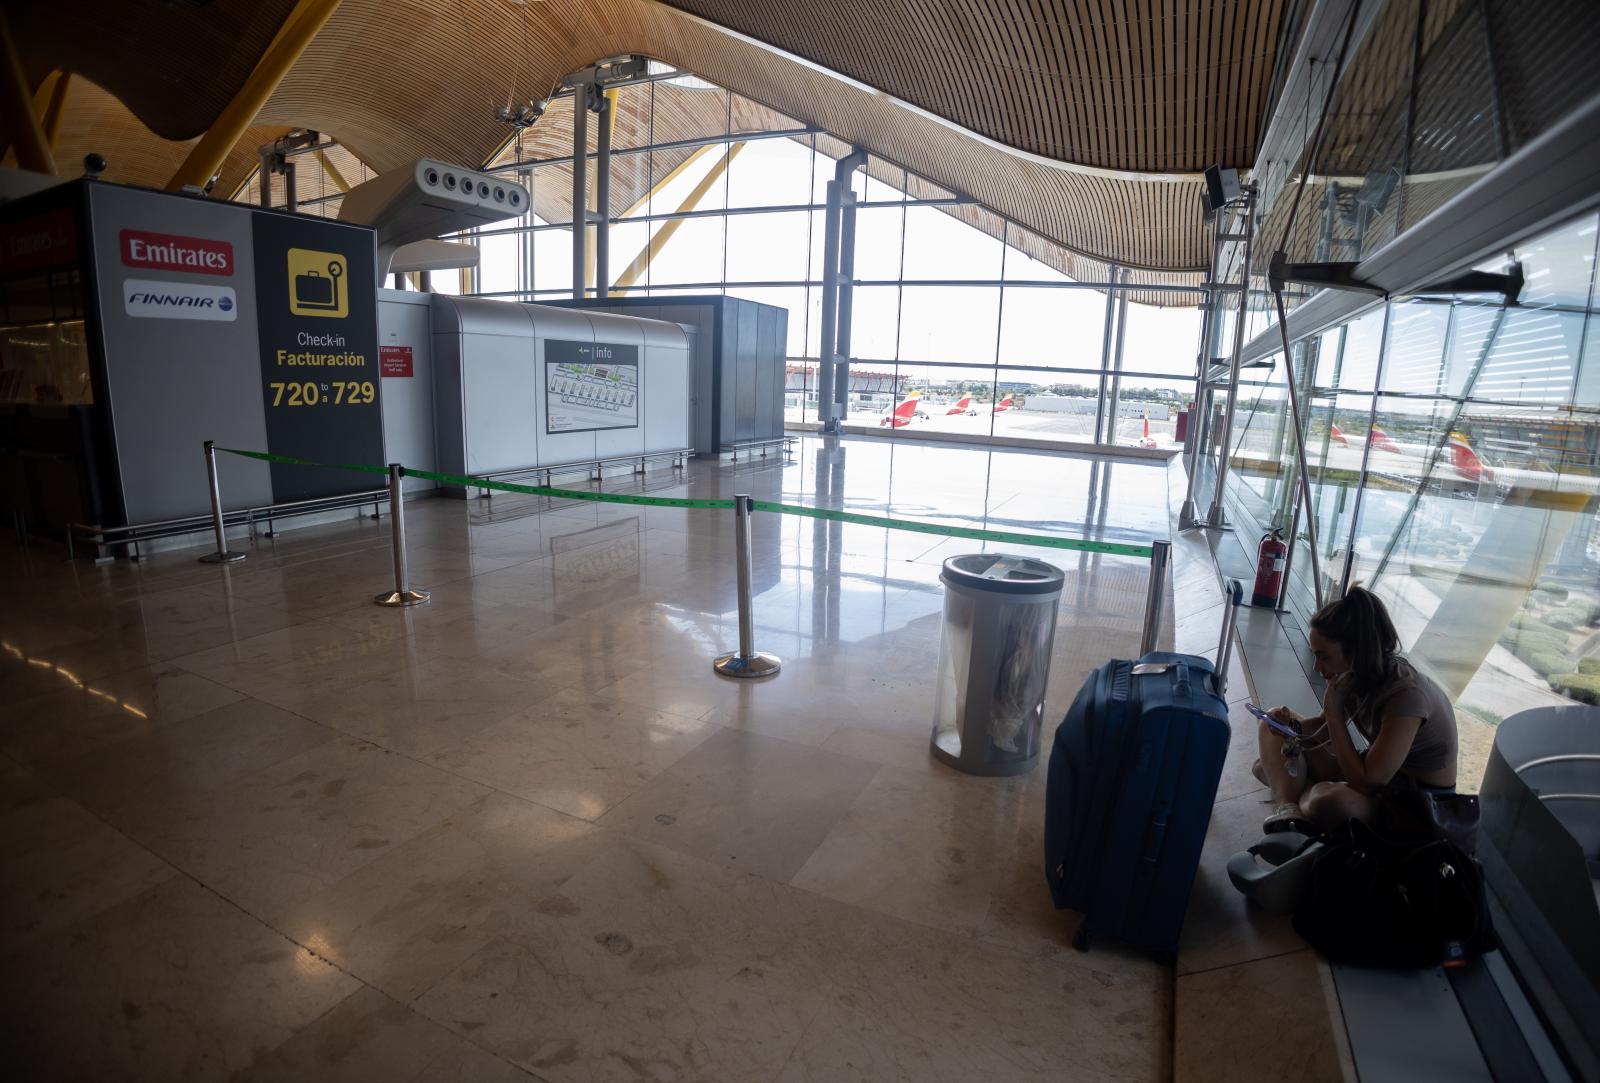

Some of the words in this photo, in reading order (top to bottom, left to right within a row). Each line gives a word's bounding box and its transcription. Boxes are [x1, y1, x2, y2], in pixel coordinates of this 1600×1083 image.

[129, 239, 227, 268] Emirates
[129, 293, 214, 308] FINNAIR
[297, 331, 345, 347] Check-in
[277, 350, 365, 367] Facturación
[270, 382, 319, 406] 720
[321, 383, 329, 391] to
[332, 381, 375, 405] 729
[322, 395, 328, 403] a
